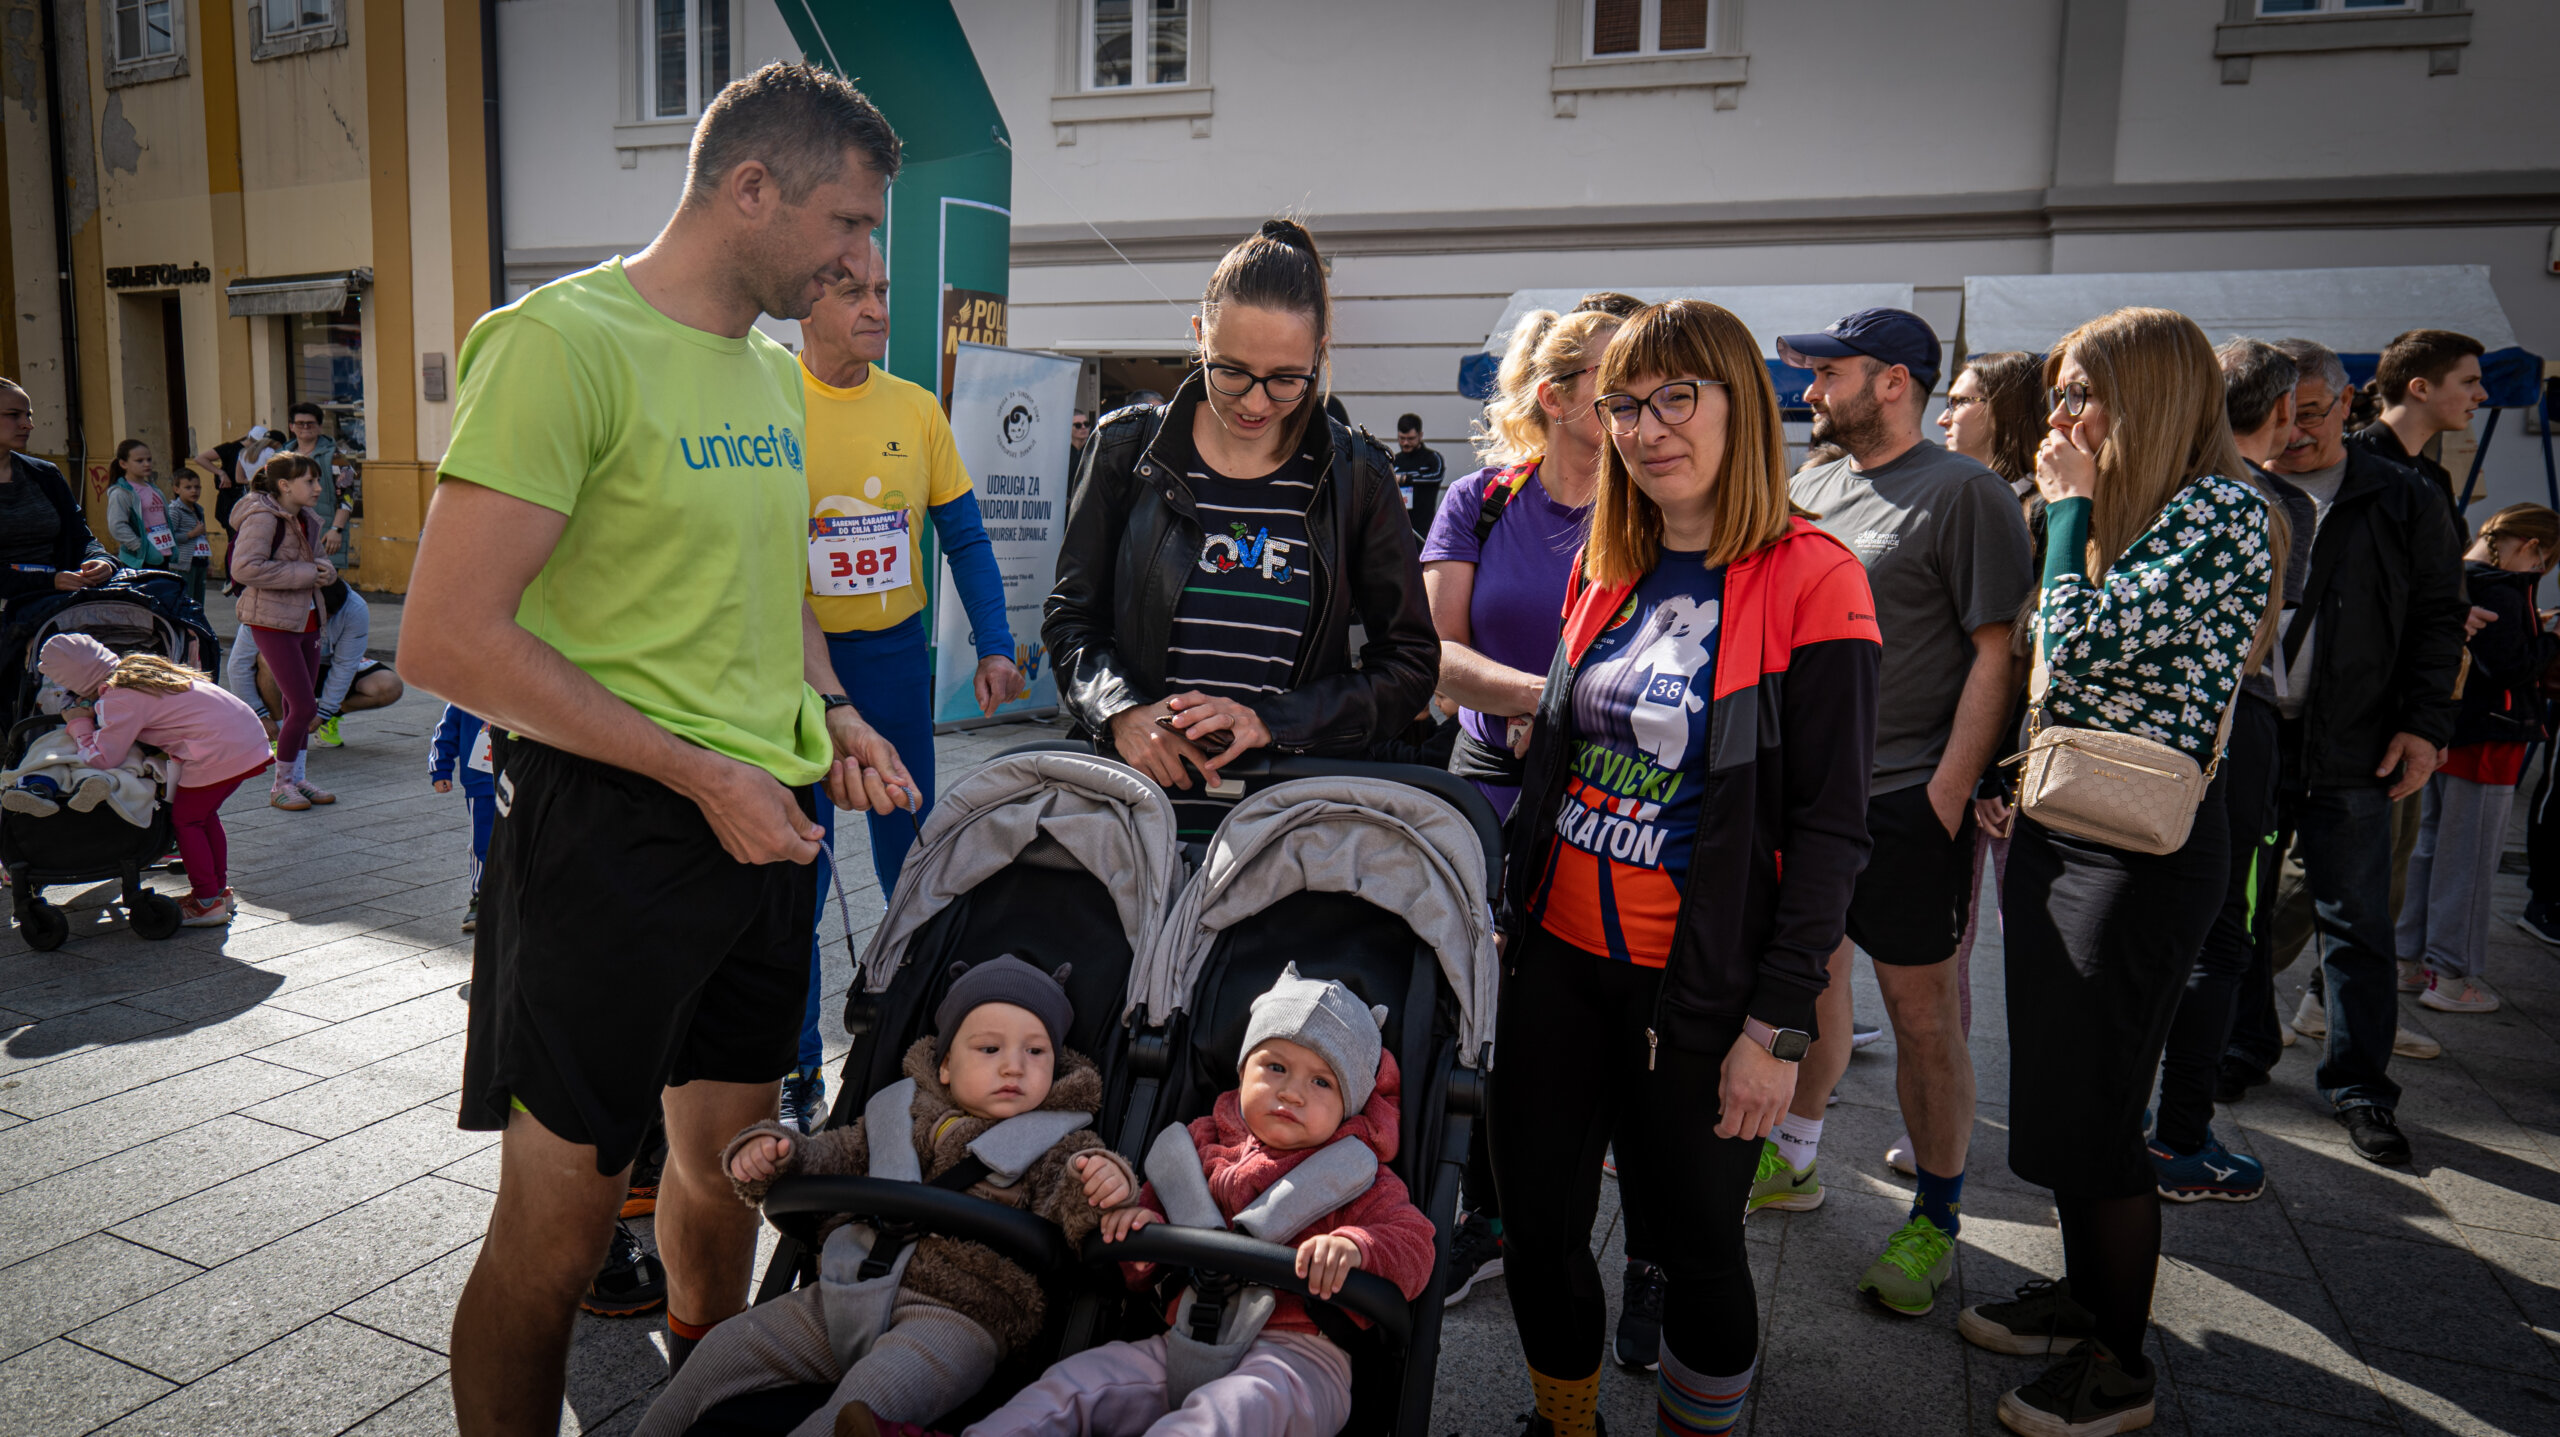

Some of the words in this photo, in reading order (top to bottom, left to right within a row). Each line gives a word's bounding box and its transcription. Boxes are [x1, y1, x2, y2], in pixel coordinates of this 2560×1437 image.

[680, 422, 782, 470] unicef
[986, 474, 1026, 496] UDRUGA
[1027, 476, 1040, 496] ZA
[1021, 500, 1052, 520] DOWN
[831, 519, 860, 528] ŠARENIM
[838, 527, 849, 535] DO
[851, 525, 871, 534] CILJA
[1018, 526, 1048, 541] ŽUPANIJE
[829, 546, 897, 577] 387
[1652, 678, 1682, 700] 38
